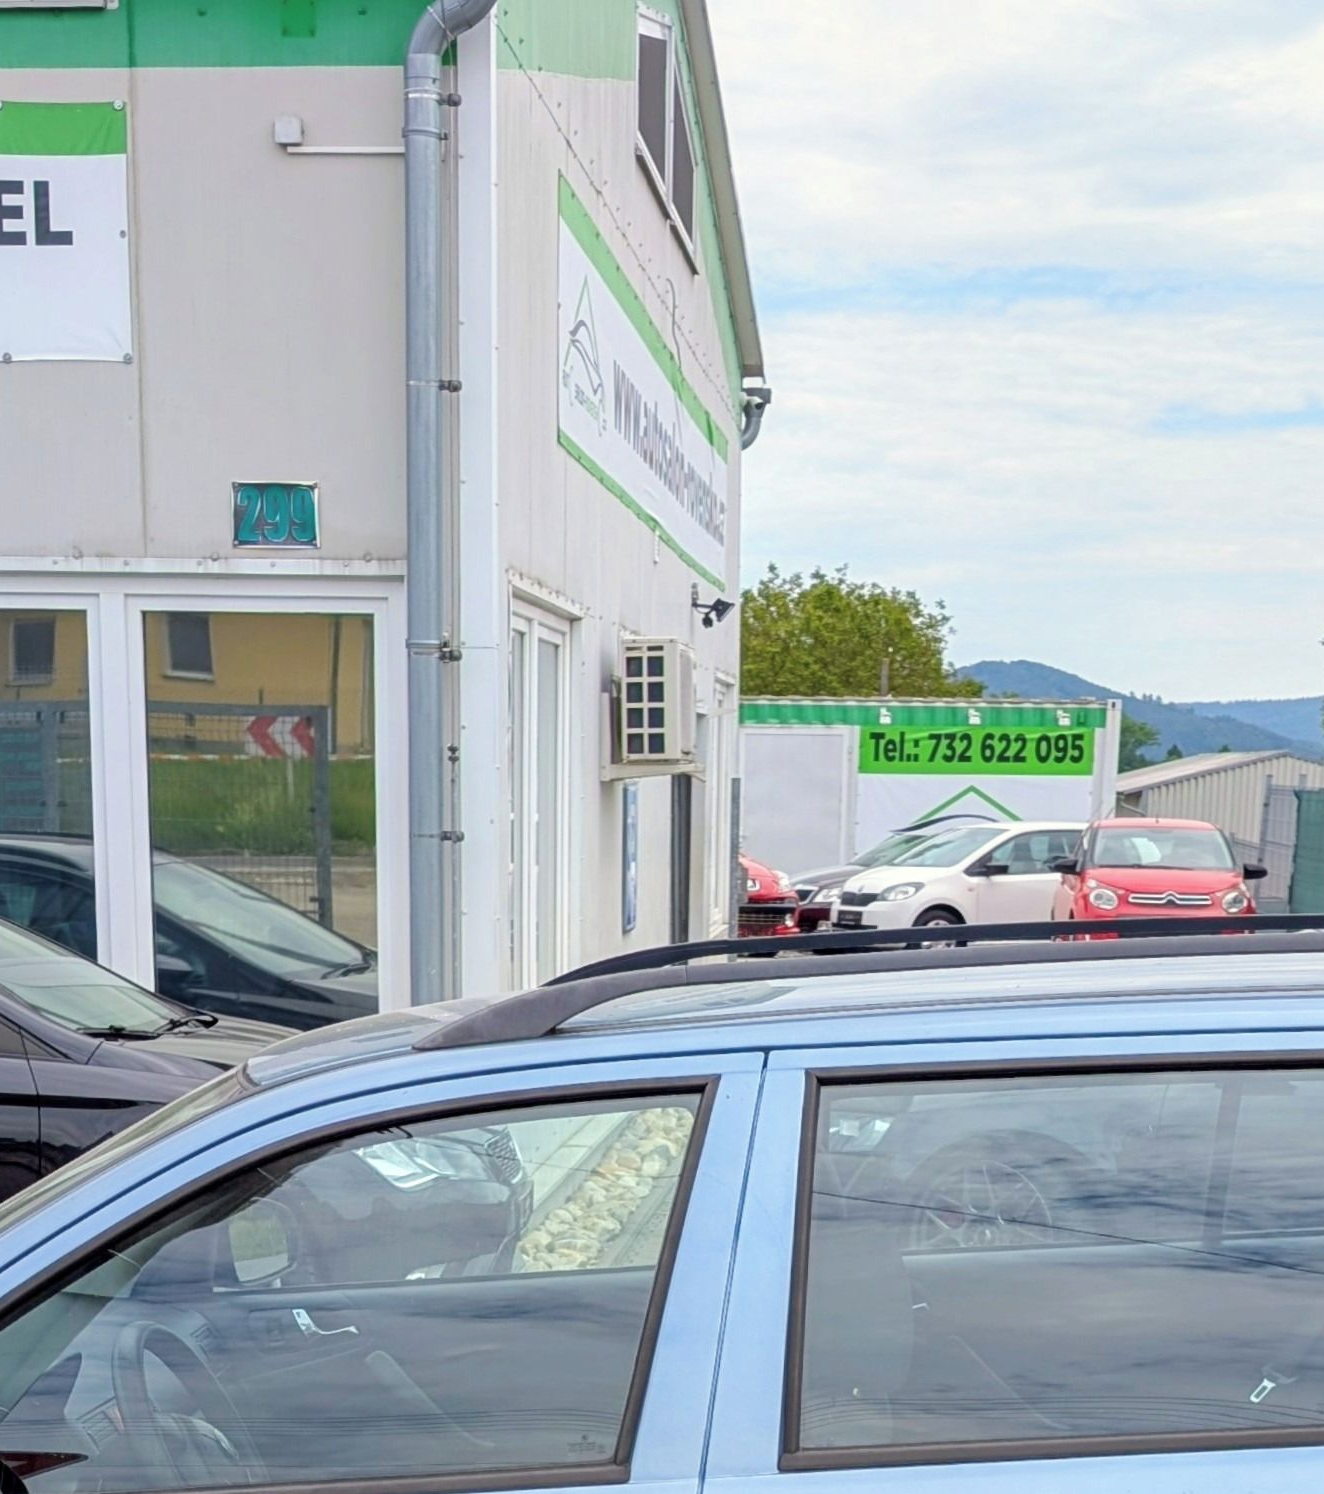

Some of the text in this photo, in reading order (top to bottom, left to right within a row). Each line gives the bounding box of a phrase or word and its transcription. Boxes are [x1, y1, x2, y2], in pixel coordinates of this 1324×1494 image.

[236, 484, 316, 543] 299
[868, 731, 1085, 765] Tel.: 732 622 095
